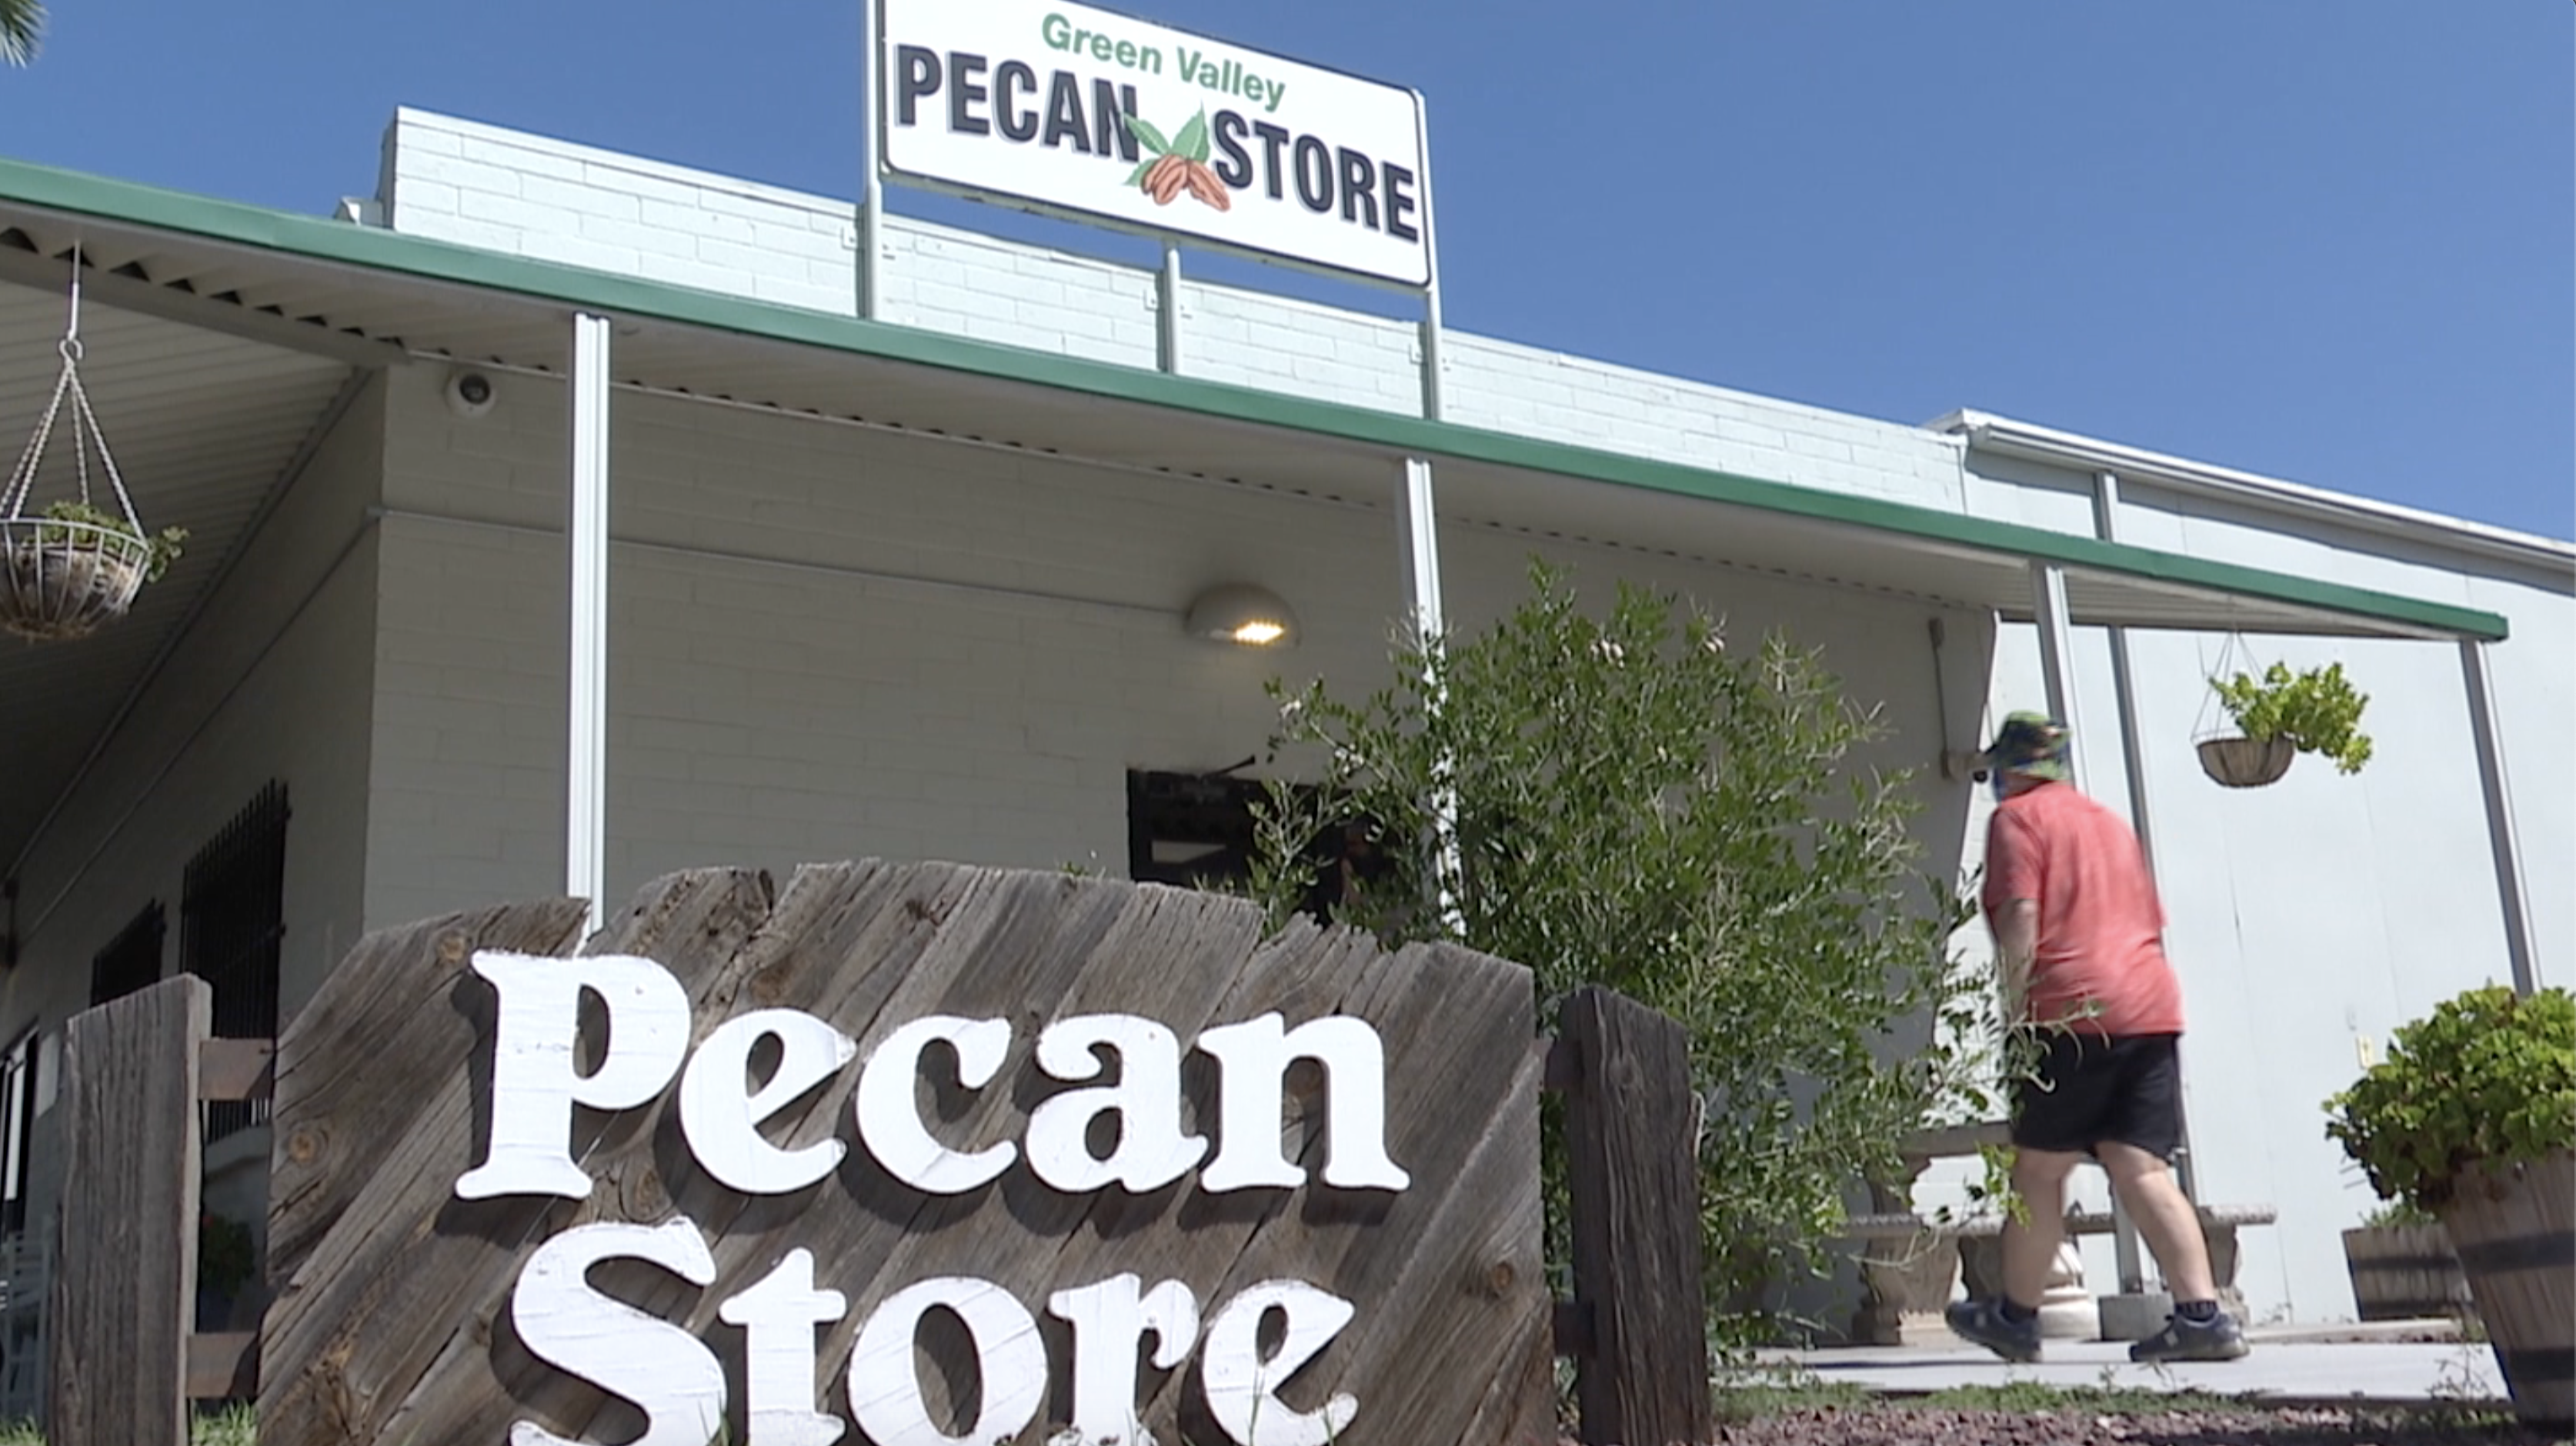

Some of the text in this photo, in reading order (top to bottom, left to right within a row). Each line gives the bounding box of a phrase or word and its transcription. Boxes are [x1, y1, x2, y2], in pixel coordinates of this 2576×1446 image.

[894, 44, 1419, 243] PECAN STORE
[1041, 13, 1286, 112] Green Valley
[455, 949, 1410, 1200] Pecan
[509, 1215, 1360, 1446] Store
